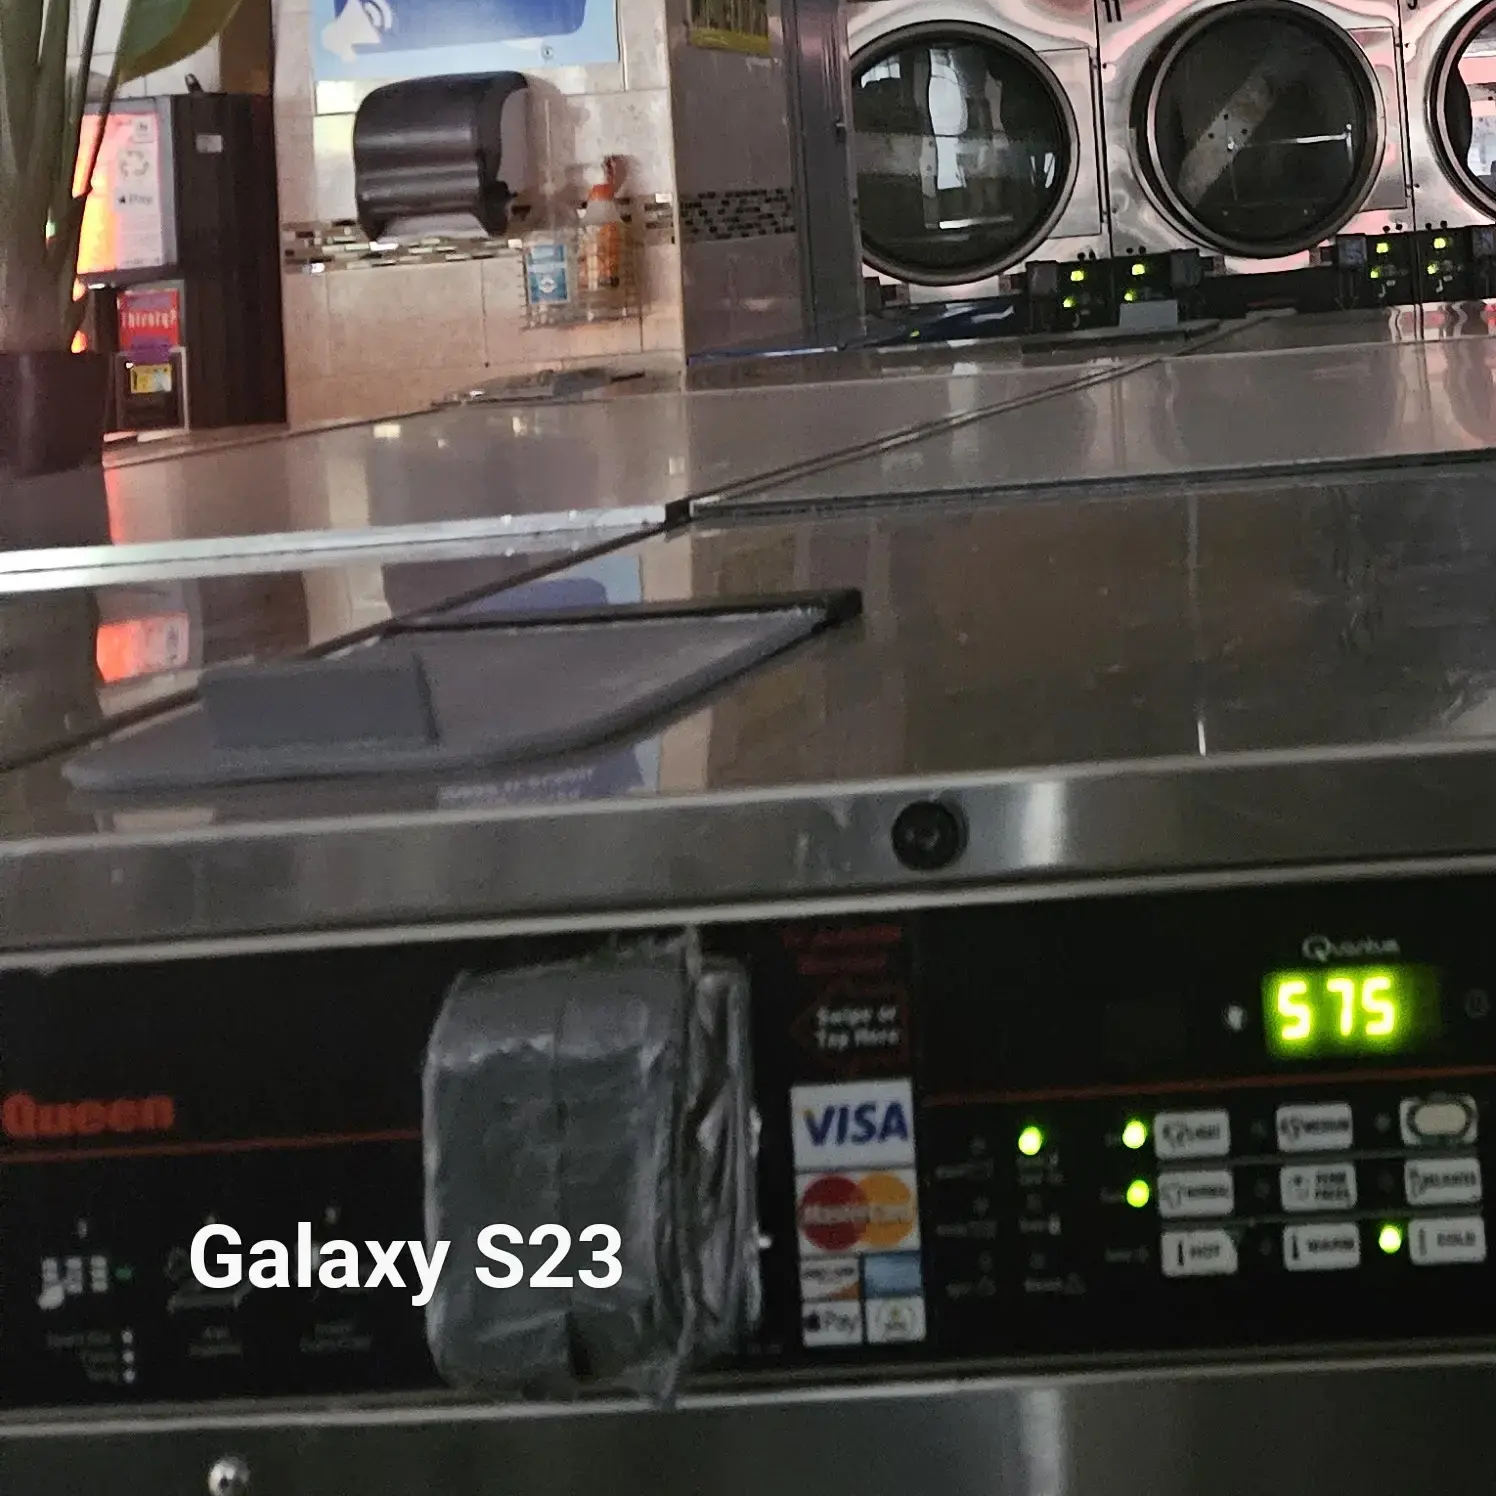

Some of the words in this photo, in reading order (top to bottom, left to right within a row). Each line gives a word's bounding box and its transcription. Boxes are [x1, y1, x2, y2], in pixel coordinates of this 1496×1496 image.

[1301, 934, 1399, 962] Quantum
[2, 1091, 175, 1139] Queen
[803, 1101, 910, 1146] VISA
